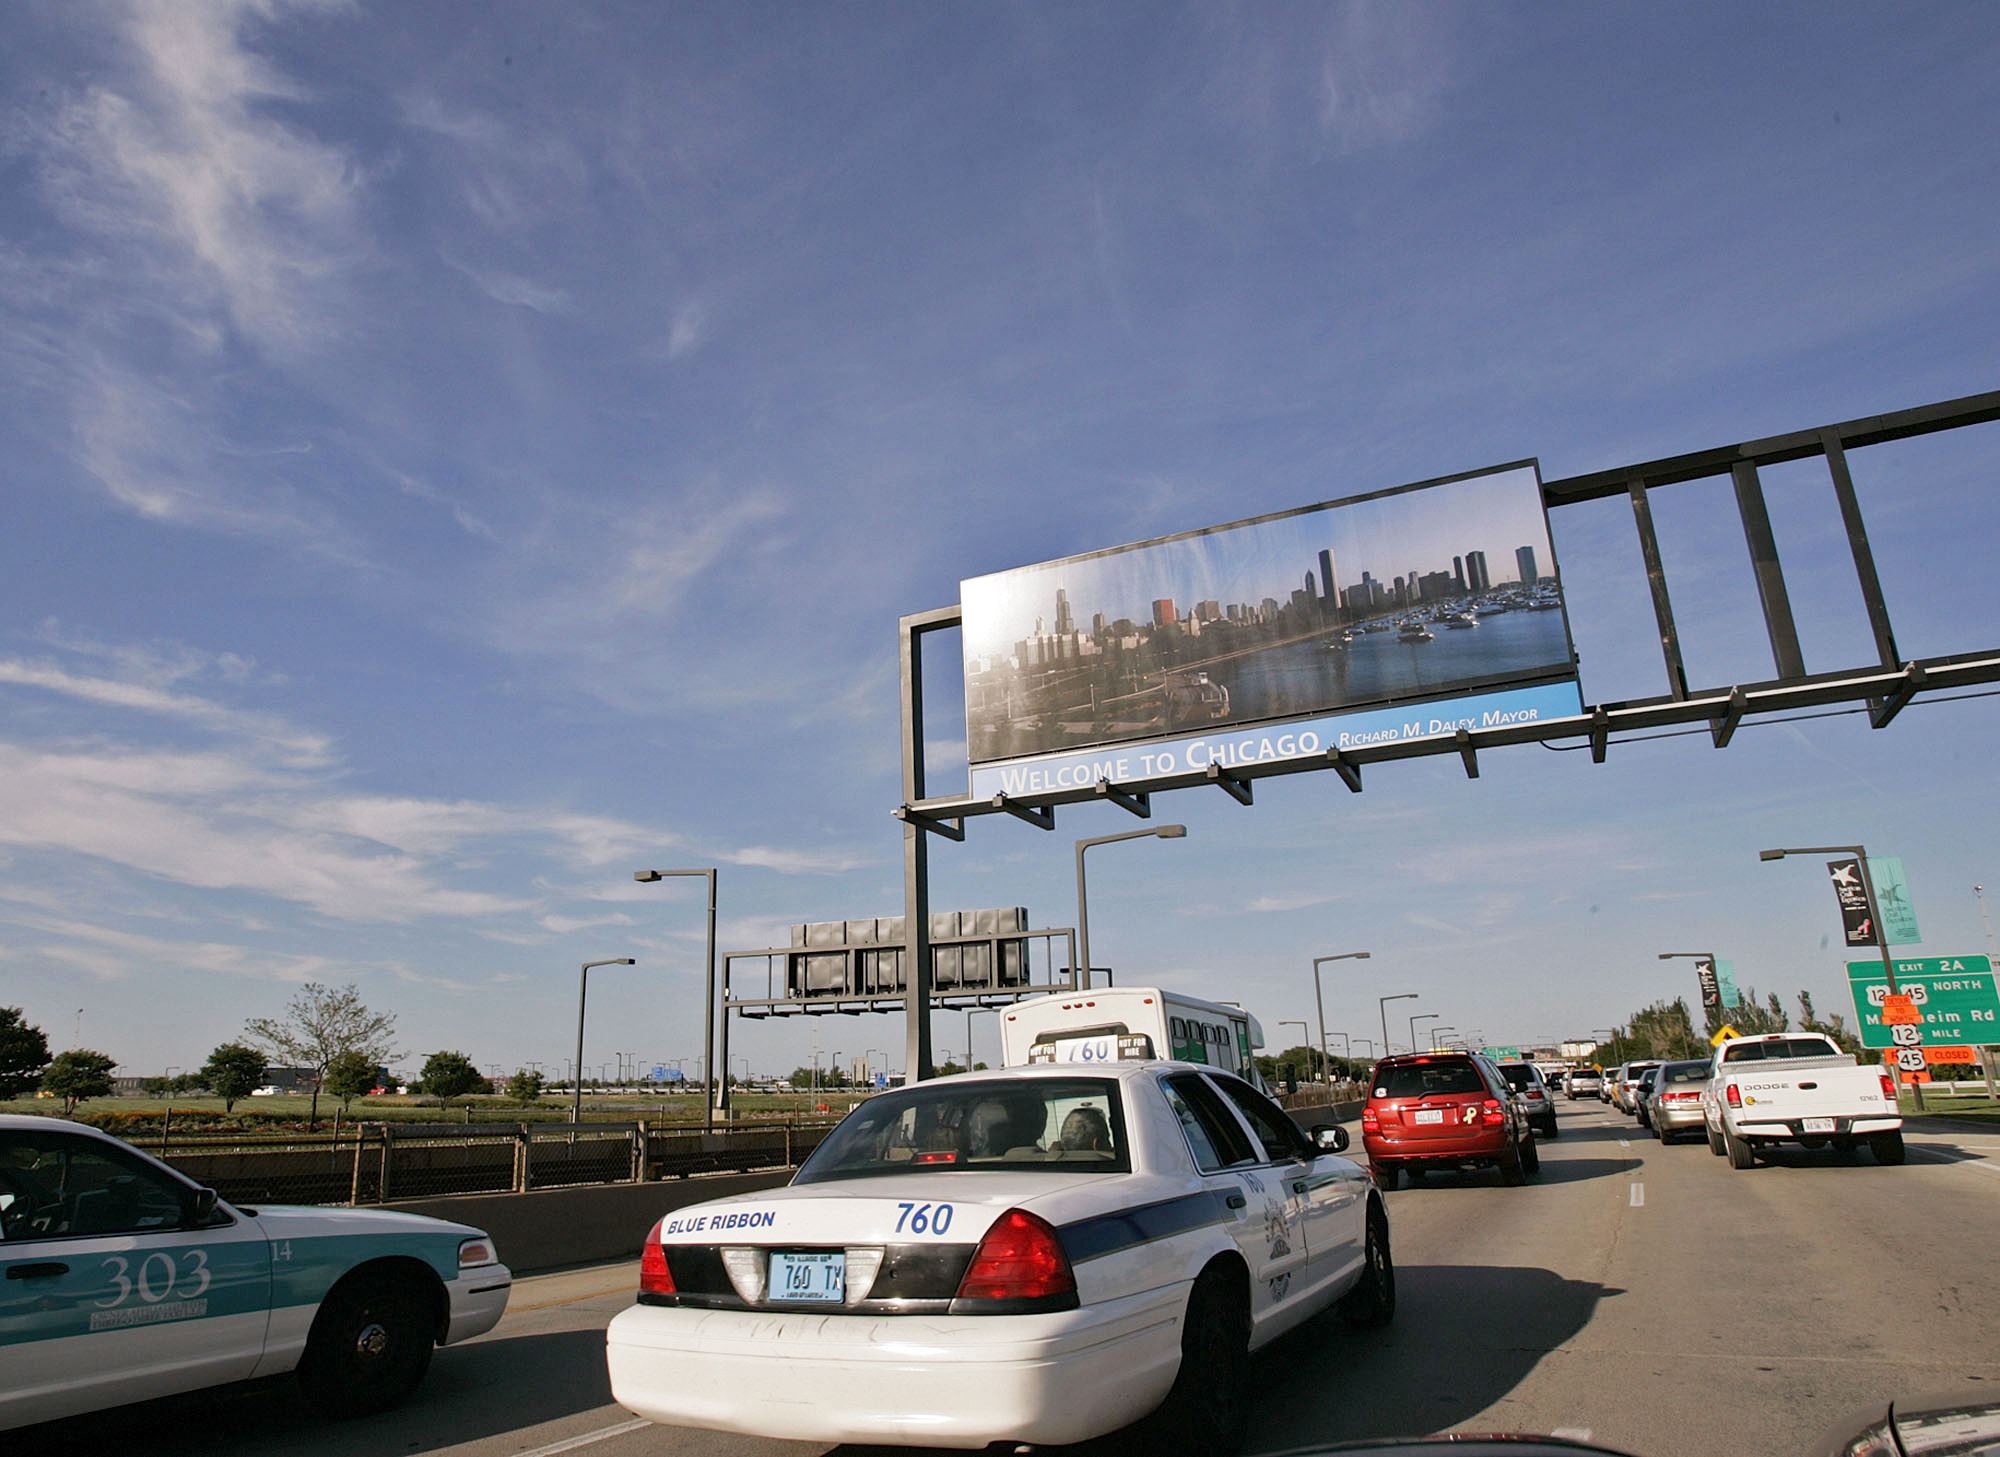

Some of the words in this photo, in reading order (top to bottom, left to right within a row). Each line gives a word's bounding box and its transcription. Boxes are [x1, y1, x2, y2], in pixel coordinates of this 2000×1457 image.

[1339, 728, 1398, 747] RICHARD
[1403, 722, 1424, 738] M.
[1482, 708, 1538, 727] MAYOR
[1000, 758, 1129, 793] WELCOME
[1140, 752, 1175, 775] TO
[1186, 731, 1319, 768] CHICAGO
[1899, 963, 1924, 972] EXIT
[1940, 960, 1965, 971] 2A
[1933, 980, 1982, 991] NORTH
[1971, 1009, 1995, 1022] Rd
[1895, 1028, 1915, 1041] 12
[1932, 1029, 1961, 1038] MILE
[1119, 1038, 1132, 1048] NOT
[1133, 1037, 1147, 1047] FOR
[1125, 1047, 1140, 1056] HIRE
[1935, 1051, 1969, 1060] CLOSED
[1900, 1053, 1922, 1066] 45
[1744, 1083, 1790, 1091] DODGE
[667, 1217, 707, 1235] BLUE
[710, 1211, 776, 1231] RIBBON
[895, 1202, 954, 1236] 760
[271, 1240, 293, 1262] 14
[95, 1249, 212, 1308] 303
[786, 1264, 812, 1290] 760
[825, 1264, 842, 1291] TX
